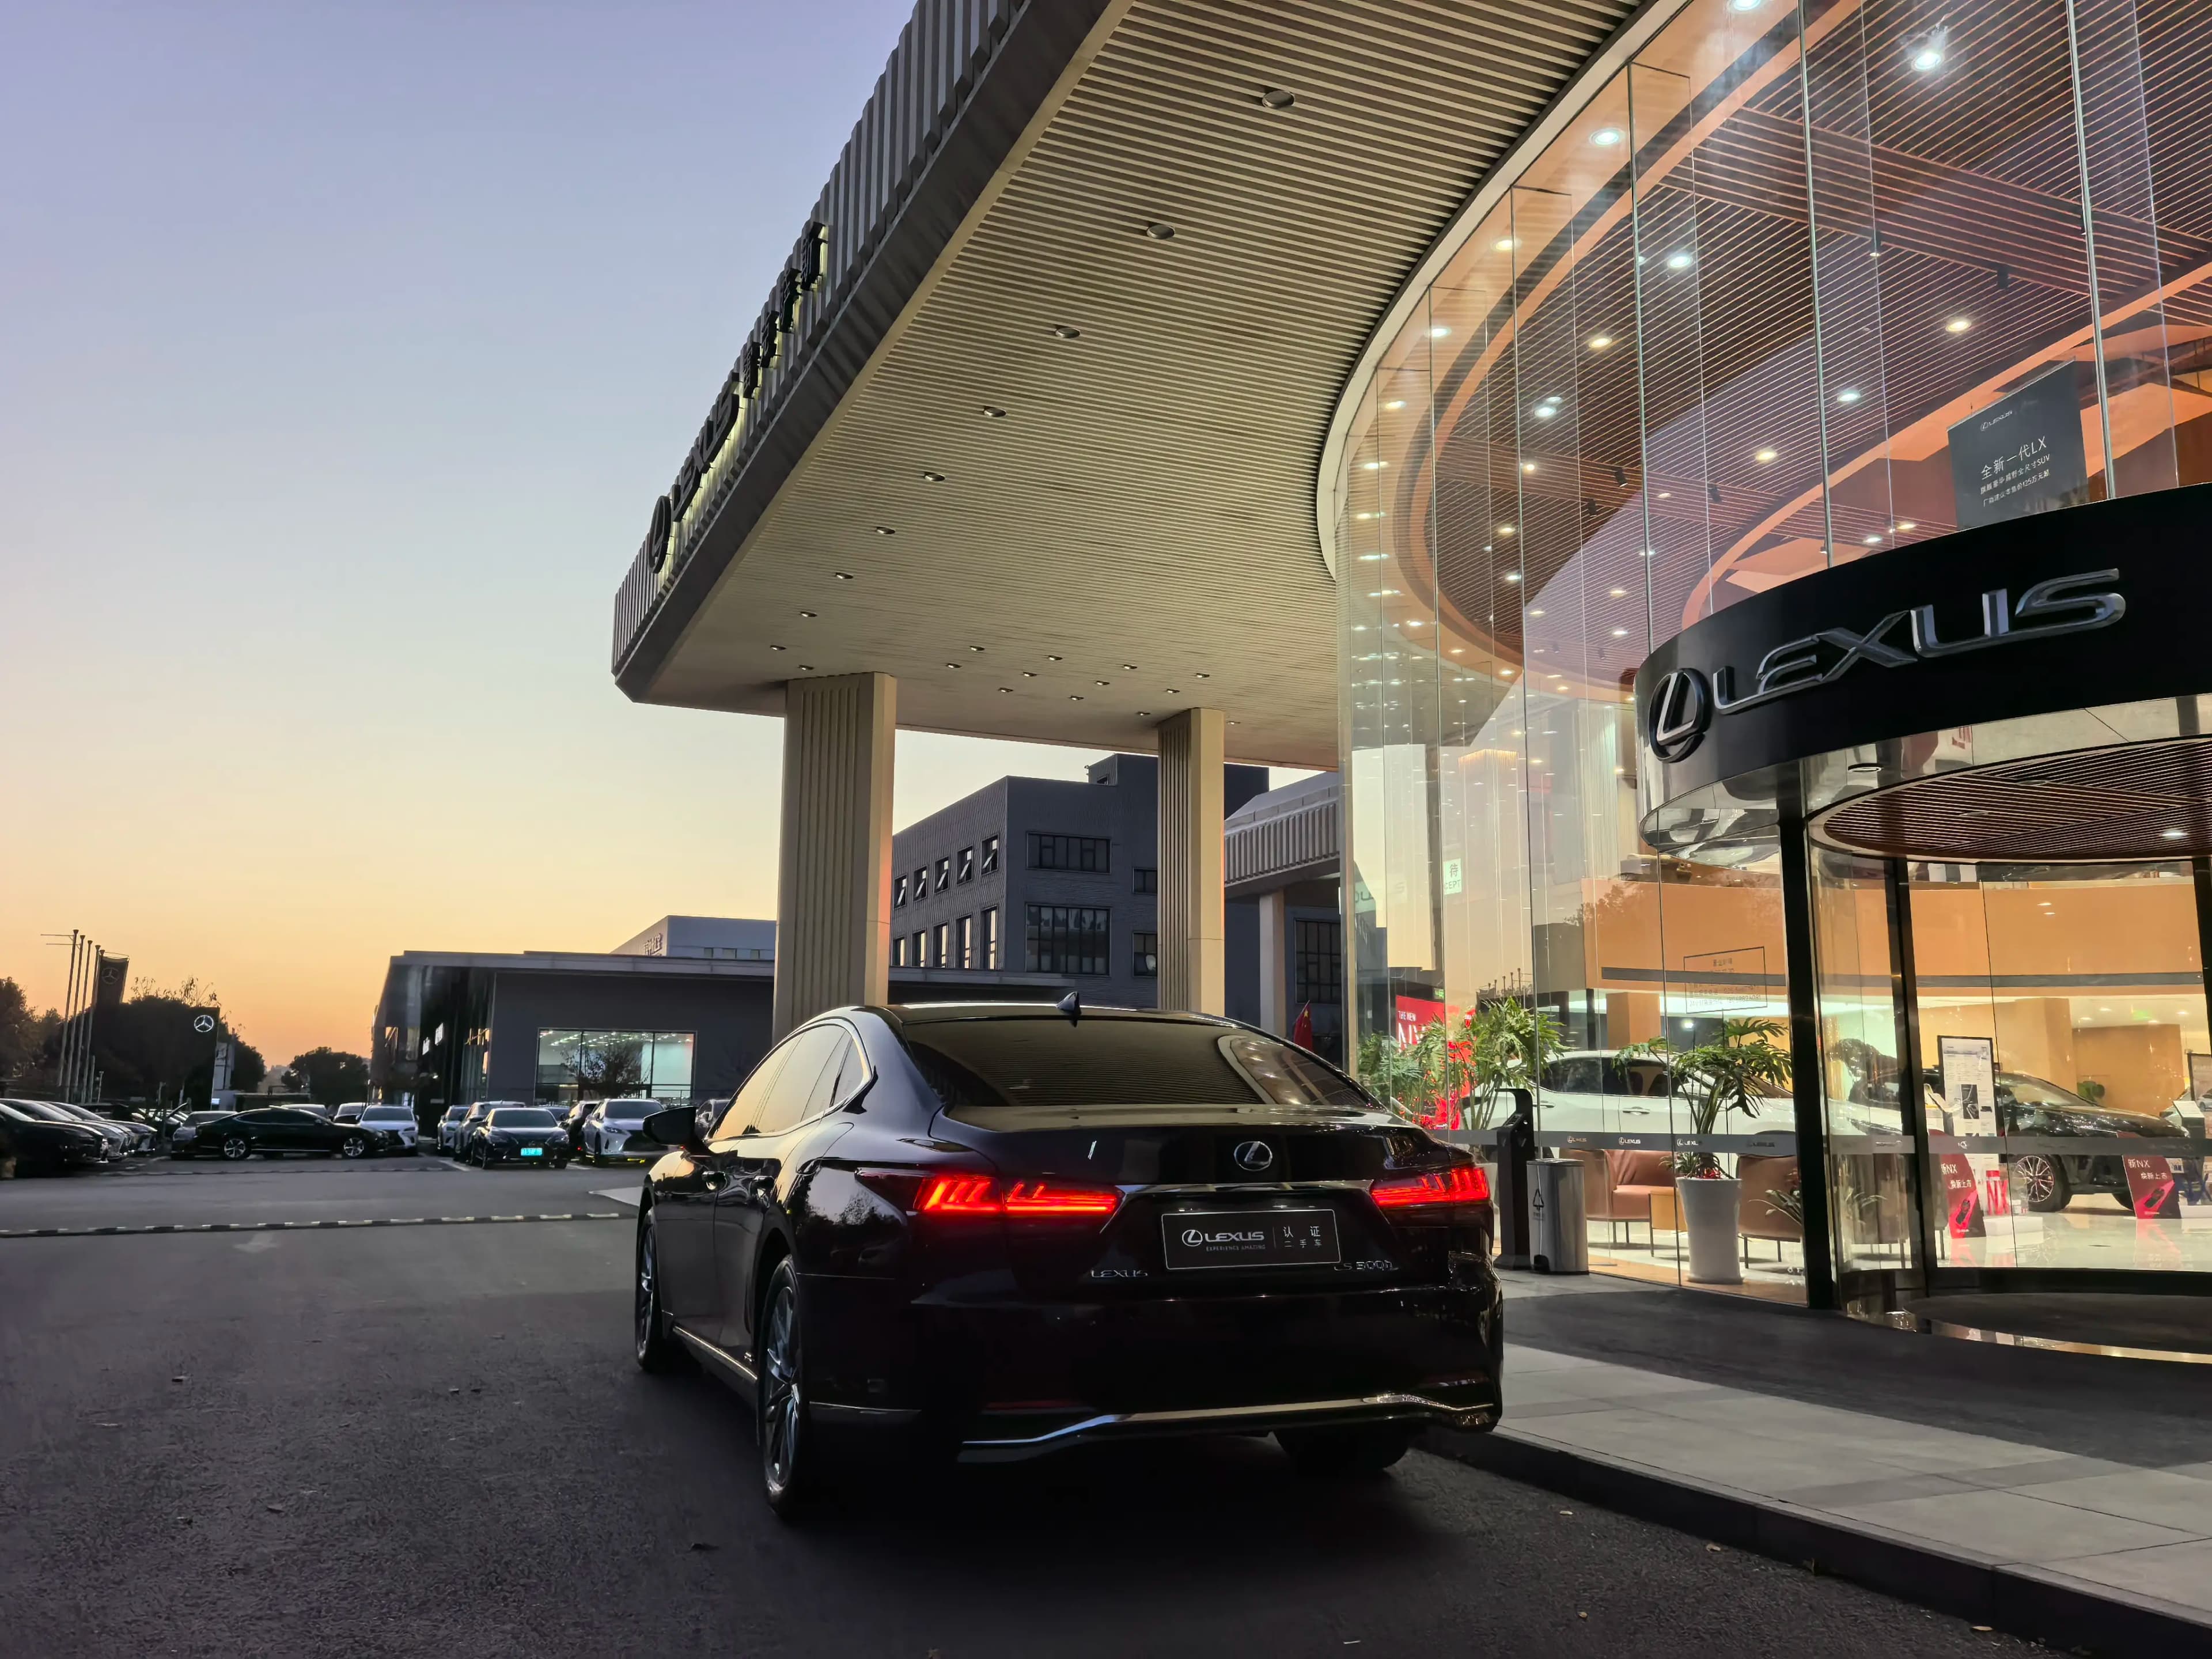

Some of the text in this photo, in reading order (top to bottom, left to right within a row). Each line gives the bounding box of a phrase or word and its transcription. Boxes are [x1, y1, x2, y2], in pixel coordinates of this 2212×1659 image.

[671, 372, 740, 522] LEXUS
[1981, 435, 2047, 480] 全新一代LX
[1712, 567, 2127, 715] LEXUS
[2128, 1158, 2150, 1169] 新NX
[1205, 1232, 1265, 1243] LEXUS
[1283, 1225, 1321, 1238] 认证
[1284, 1239, 1322, 1248] 二手车
[1091, 1270, 1148, 1278] LEXUS
